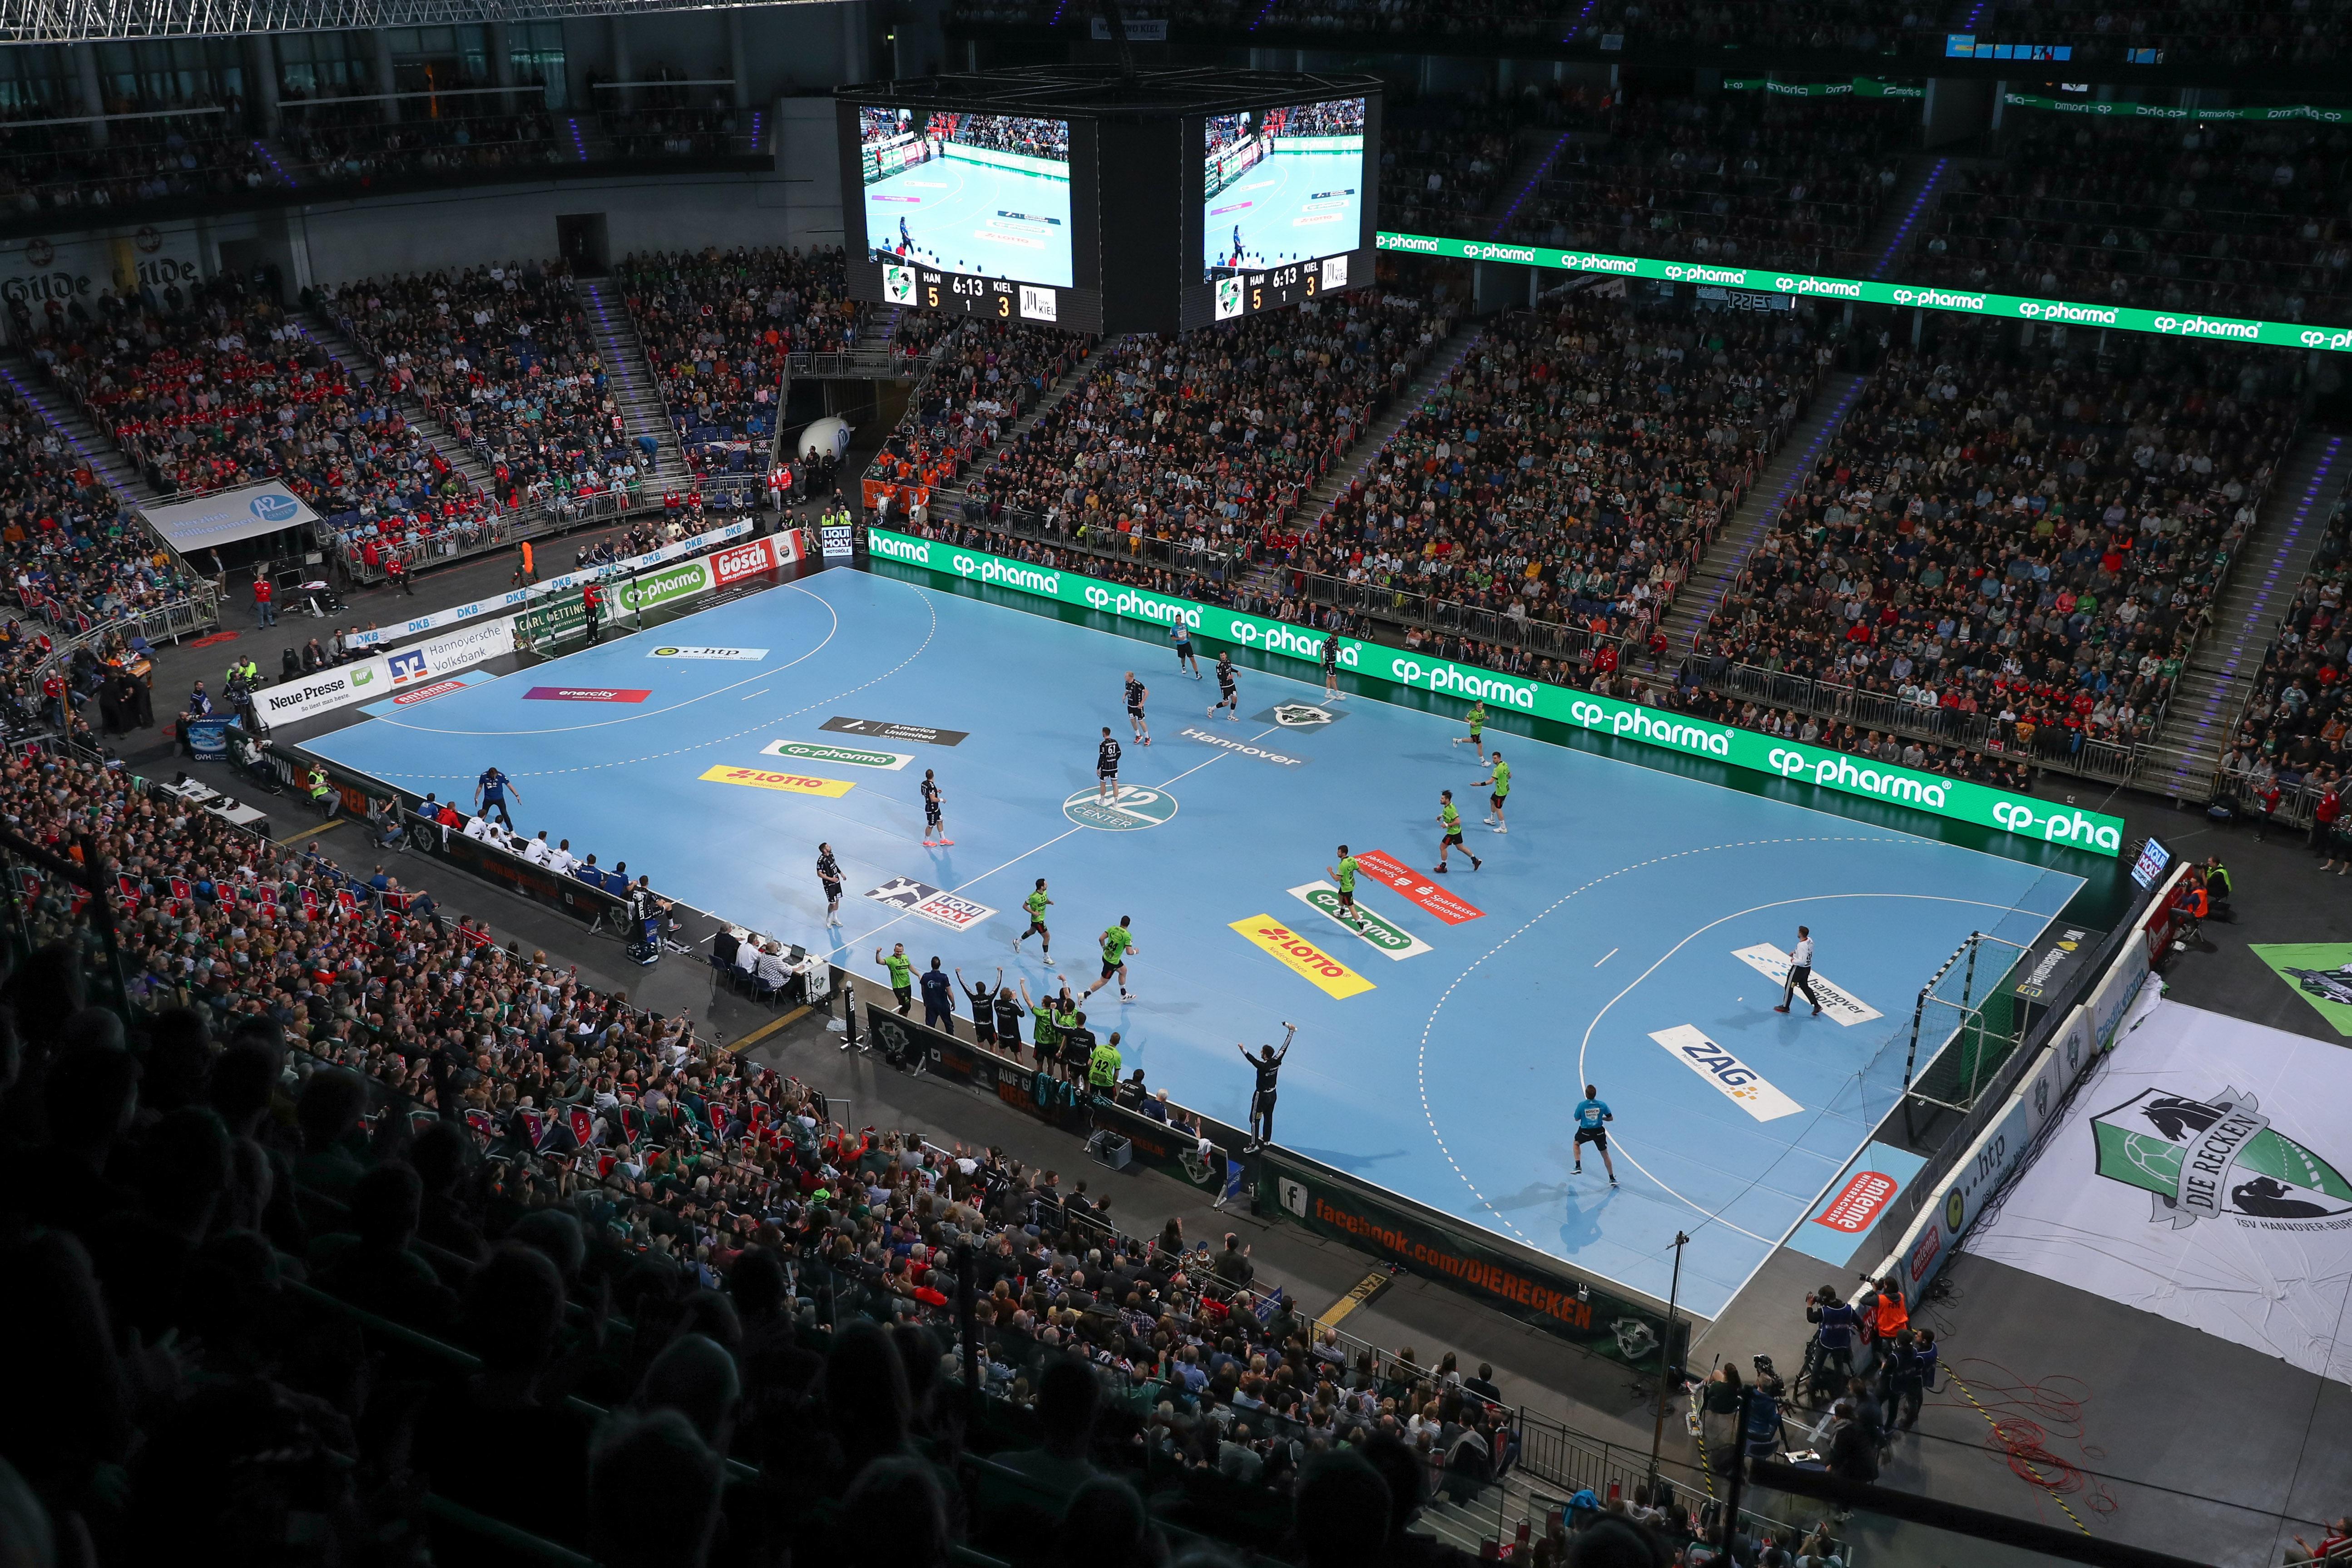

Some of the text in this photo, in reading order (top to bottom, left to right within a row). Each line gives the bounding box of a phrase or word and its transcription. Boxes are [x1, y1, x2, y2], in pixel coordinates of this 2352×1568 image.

[1304, 262, 1318, 273] KIEL
[923, 272, 941, 284] HAN
[1250, 274, 1264, 286] HAN
[1273, 267, 1297, 287] 6:13
[1335, 272, 1347, 282] KIEL
[953, 277, 983, 297] 6:13
[993, 281, 1013, 294] KIEL
[1307, 276, 1315, 296] 3
[928, 287, 939, 307] 5
[1253, 289, 1261, 309] 5
[1282, 291, 1286, 302] 1
[966, 300, 971, 312] 1
[999, 297, 1010, 317] 3
[1039, 304, 1056, 316] KIEL
[254, 496, 296, 520] A2
[267, 508, 295, 519] CENTER
[169, 516, 257, 539] Willkommen
[173, 512, 230, 528] Herzlich
[725, 524, 742, 537] DKB
[823, 529, 849, 539] LIQUI
[685, 537, 703, 550] DKB
[824, 538, 851, 548] MOLY
[642, 552, 661, 565] DKB
[718, 543, 767, 576] Gösch
[552, 577, 572, 590] DKB
[506, 590, 526, 604] DKB
[697, 590, 734, 605] elements
[457, 604, 479, 618] DKB
[409, 618, 430, 632] DKB
[356, 631, 379, 644] DKB
[429, 626, 501, 656] Hannoversche
[433, 647, 487, 672] Volksbank
[356, 672, 368, 682] NP
[270, 679, 345, 711] Neue Presse
[884, 729, 937, 740] Unlimited
[890, 724, 936, 734] America
[1108, 745, 1116, 754] 61
[1181, 728, 1302, 766] Hannover
[748, 781, 795, 791] Niedersachsen
[1073, 807, 1132, 828] CENTER
[1992, 801, 2119, 851] cp-pha
[2144, 842, 2167, 868] LIQUI
[1365, 855, 1407, 875] Hannover
[2139, 854, 2160, 878] MOLY
[883, 897, 909, 910] HBL
[935, 895, 985, 916] LIQUI
[1420, 898, 1466, 920] Hannover
[1430, 894, 1477, 917] Sparkasse
[923, 902, 975, 924] MOLY
[2063, 929, 2086, 941] Wir
[1268, 946, 1308, 974] Niedersachsen
[1807, 978, 1866, 1014] hannover
[1095, 1059, 1109, 1073] 42
[1682, 1042, 1757, 1086] ZAG
[999, 1067, 1018, 1086] AUF
[1977, 1135, 2005, 1182] htp
[2186, 1113, 2260, 1211] DIE RECKEN
[1826, 1174, 1869, 1223] NIEDERSACHSEN
[2235, 1217, 2257, 1228] TSV
[1315, 1197, 1592, 1330] facebook.com/DIERECKEN
